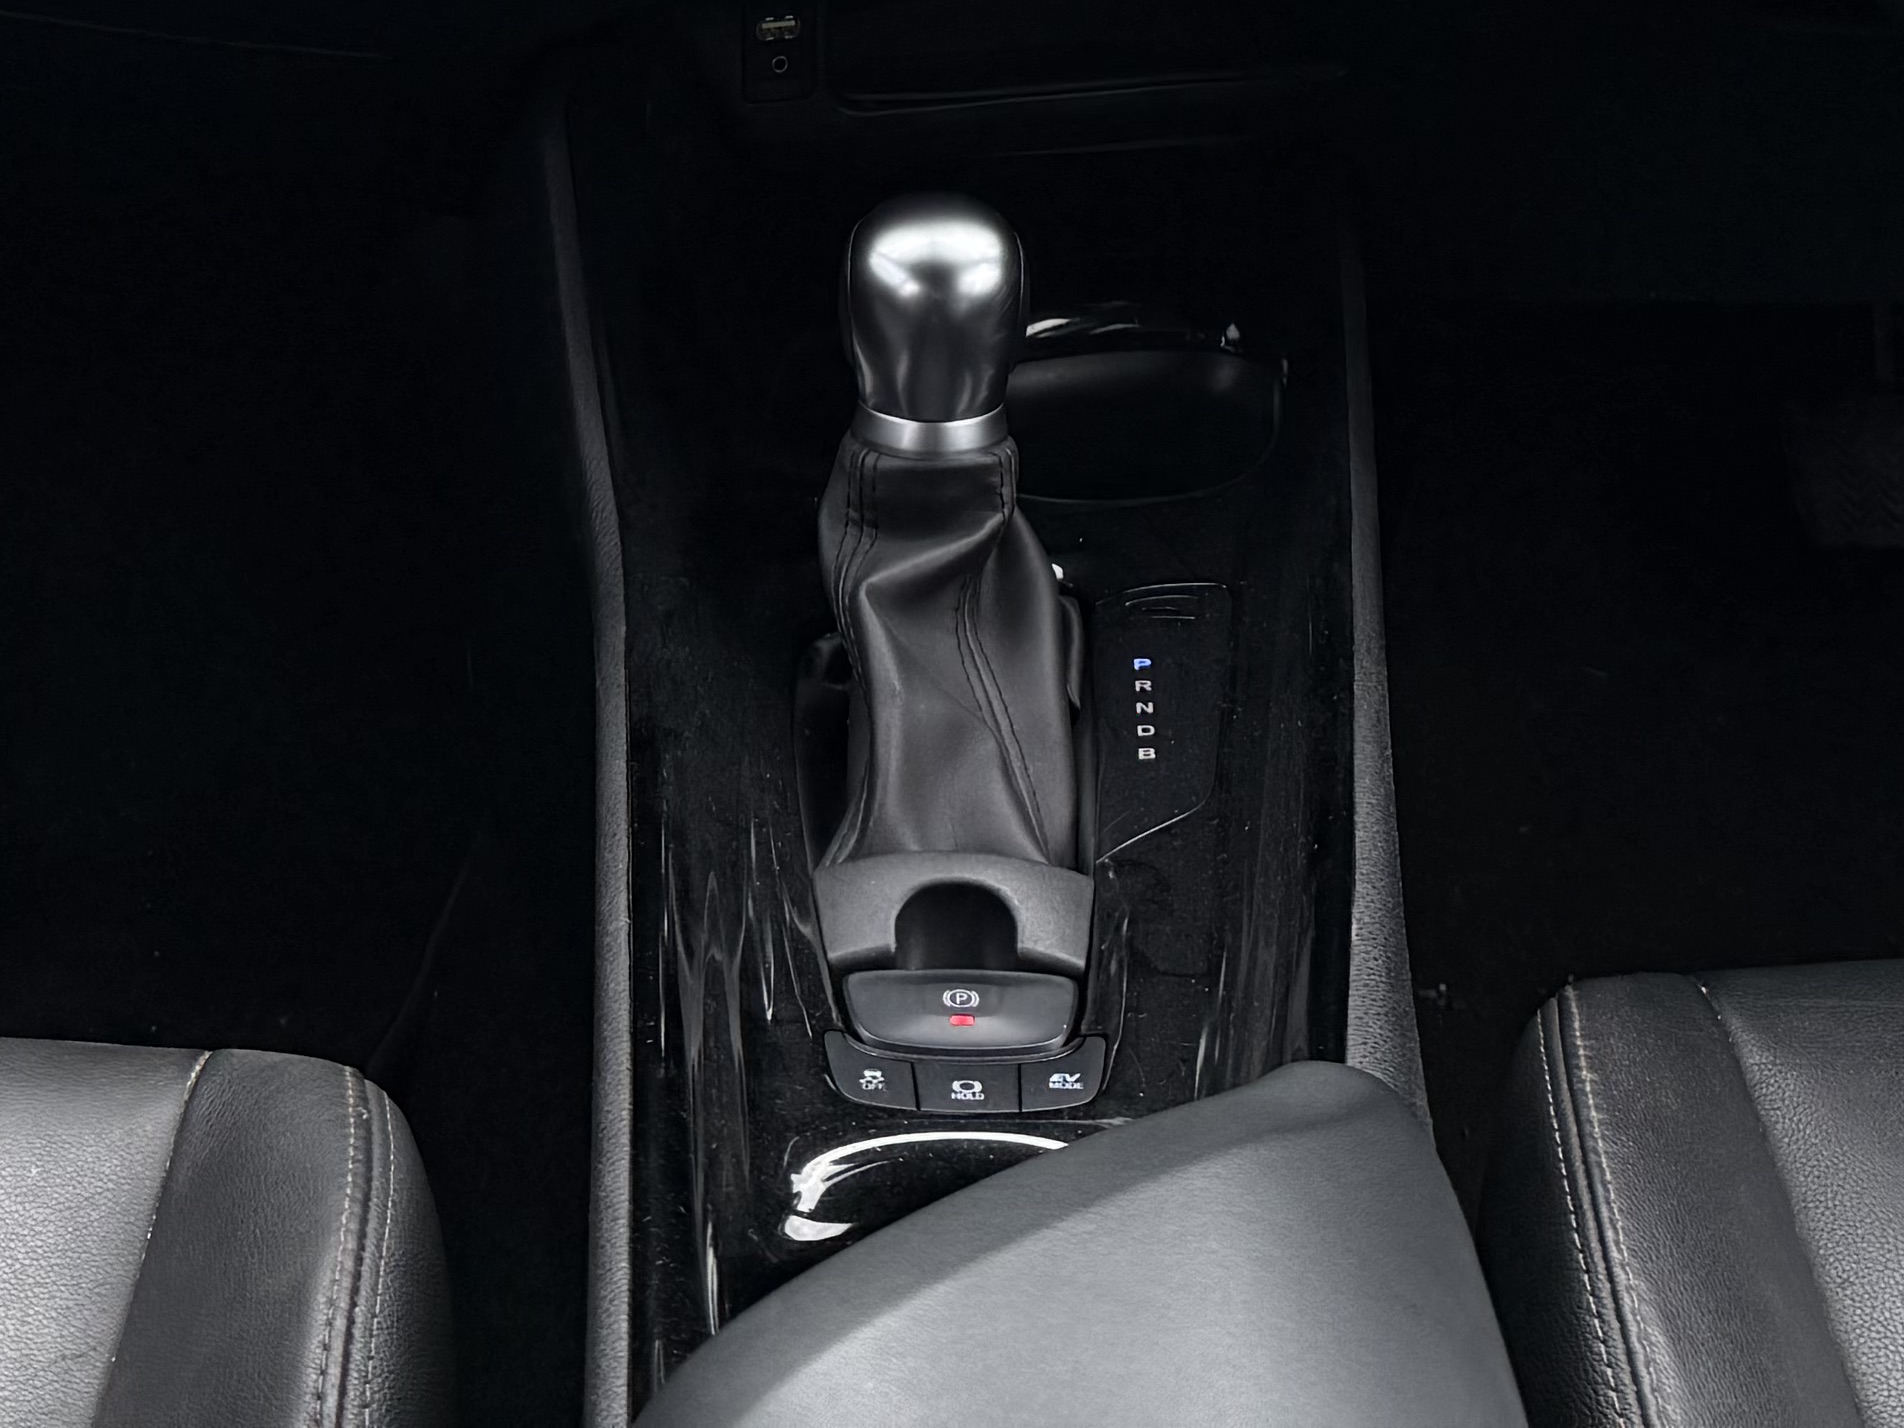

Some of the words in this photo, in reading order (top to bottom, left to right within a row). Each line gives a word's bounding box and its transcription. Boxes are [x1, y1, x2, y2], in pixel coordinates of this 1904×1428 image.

[1133, 657, 1152, 671] P
[1135, 679, 1153, 692] R
[1136, 701, 1154, 714] N
[1136, 724, 1156, 737] D
[1138, 747, 1157, 760] B
[951, 1091, 985, 1101] HOLD
